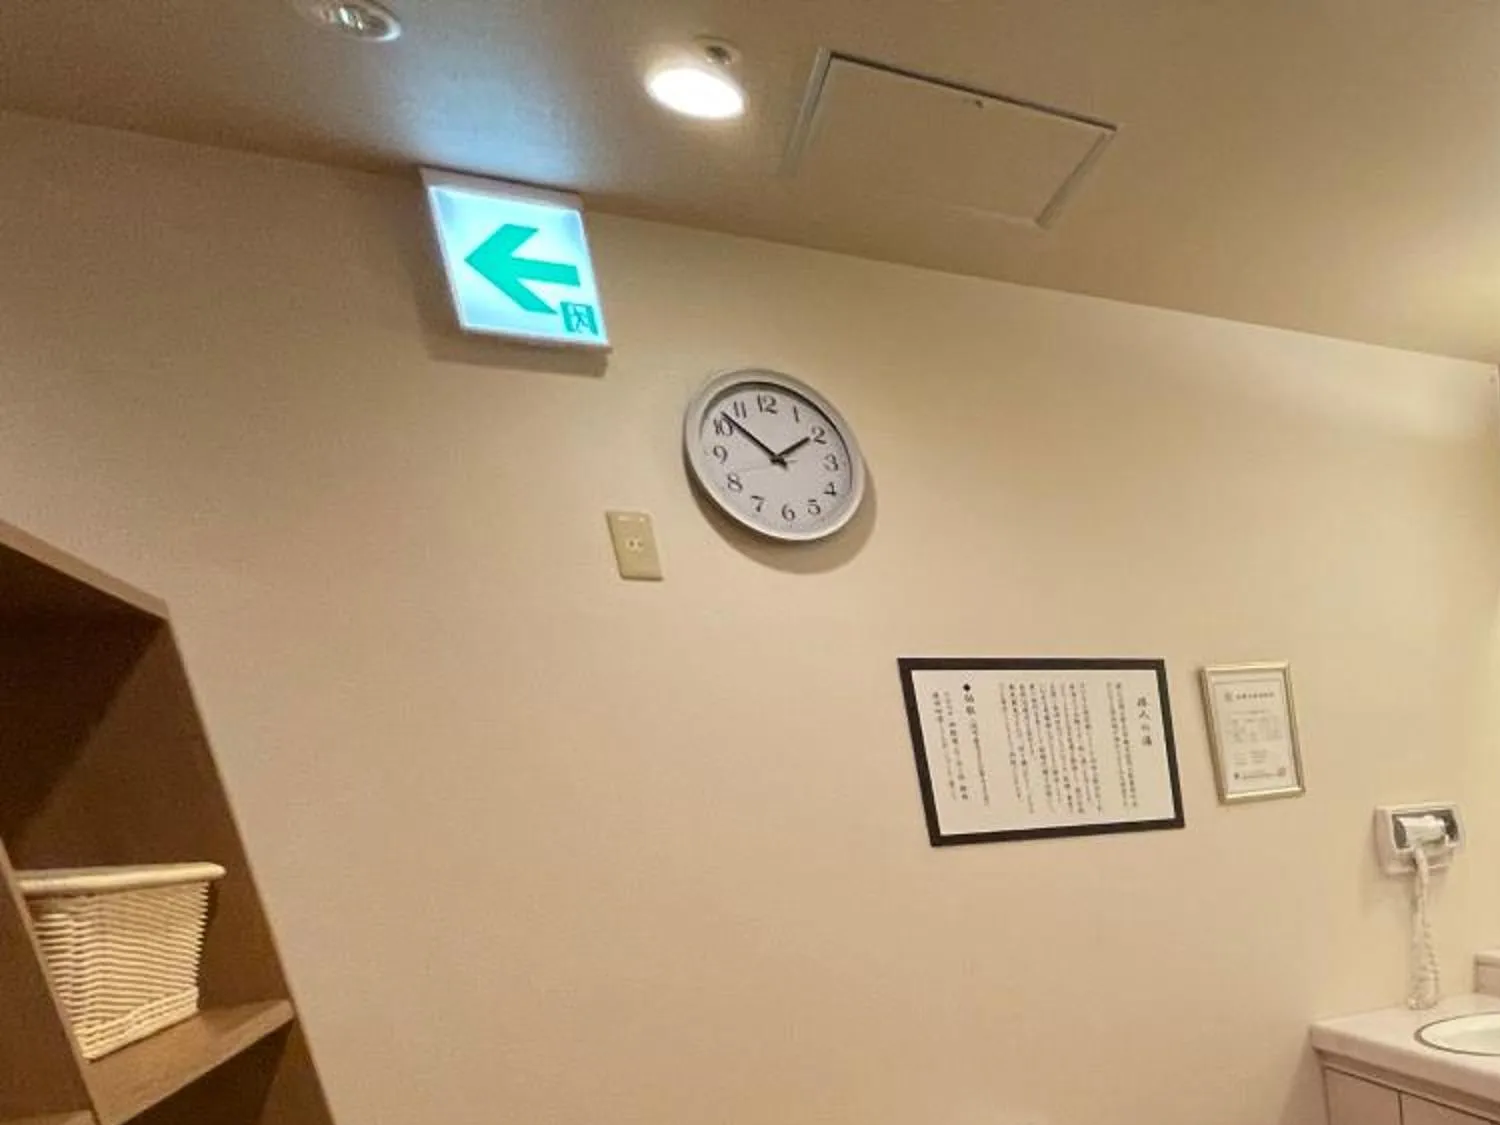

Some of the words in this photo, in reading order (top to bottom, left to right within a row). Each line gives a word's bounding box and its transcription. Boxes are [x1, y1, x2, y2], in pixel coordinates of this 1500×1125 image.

[733, 401, 747, 419] 11
[757, 394, 777, 415] 12
[793, 405, 800, 423] 1
[713, 418, 734, 437] 10
[811, 425, 827, 445] 2
[712, 445, 728, 465] 9
[823, 453, 839, 472] 3
[727, 472, 743, 493] 8
[823, 481, 837, 497] 4
[751, 495, 764, 513] 7
[781, 503, 796, 521] 6
[807, 499, 821, 515] 5
